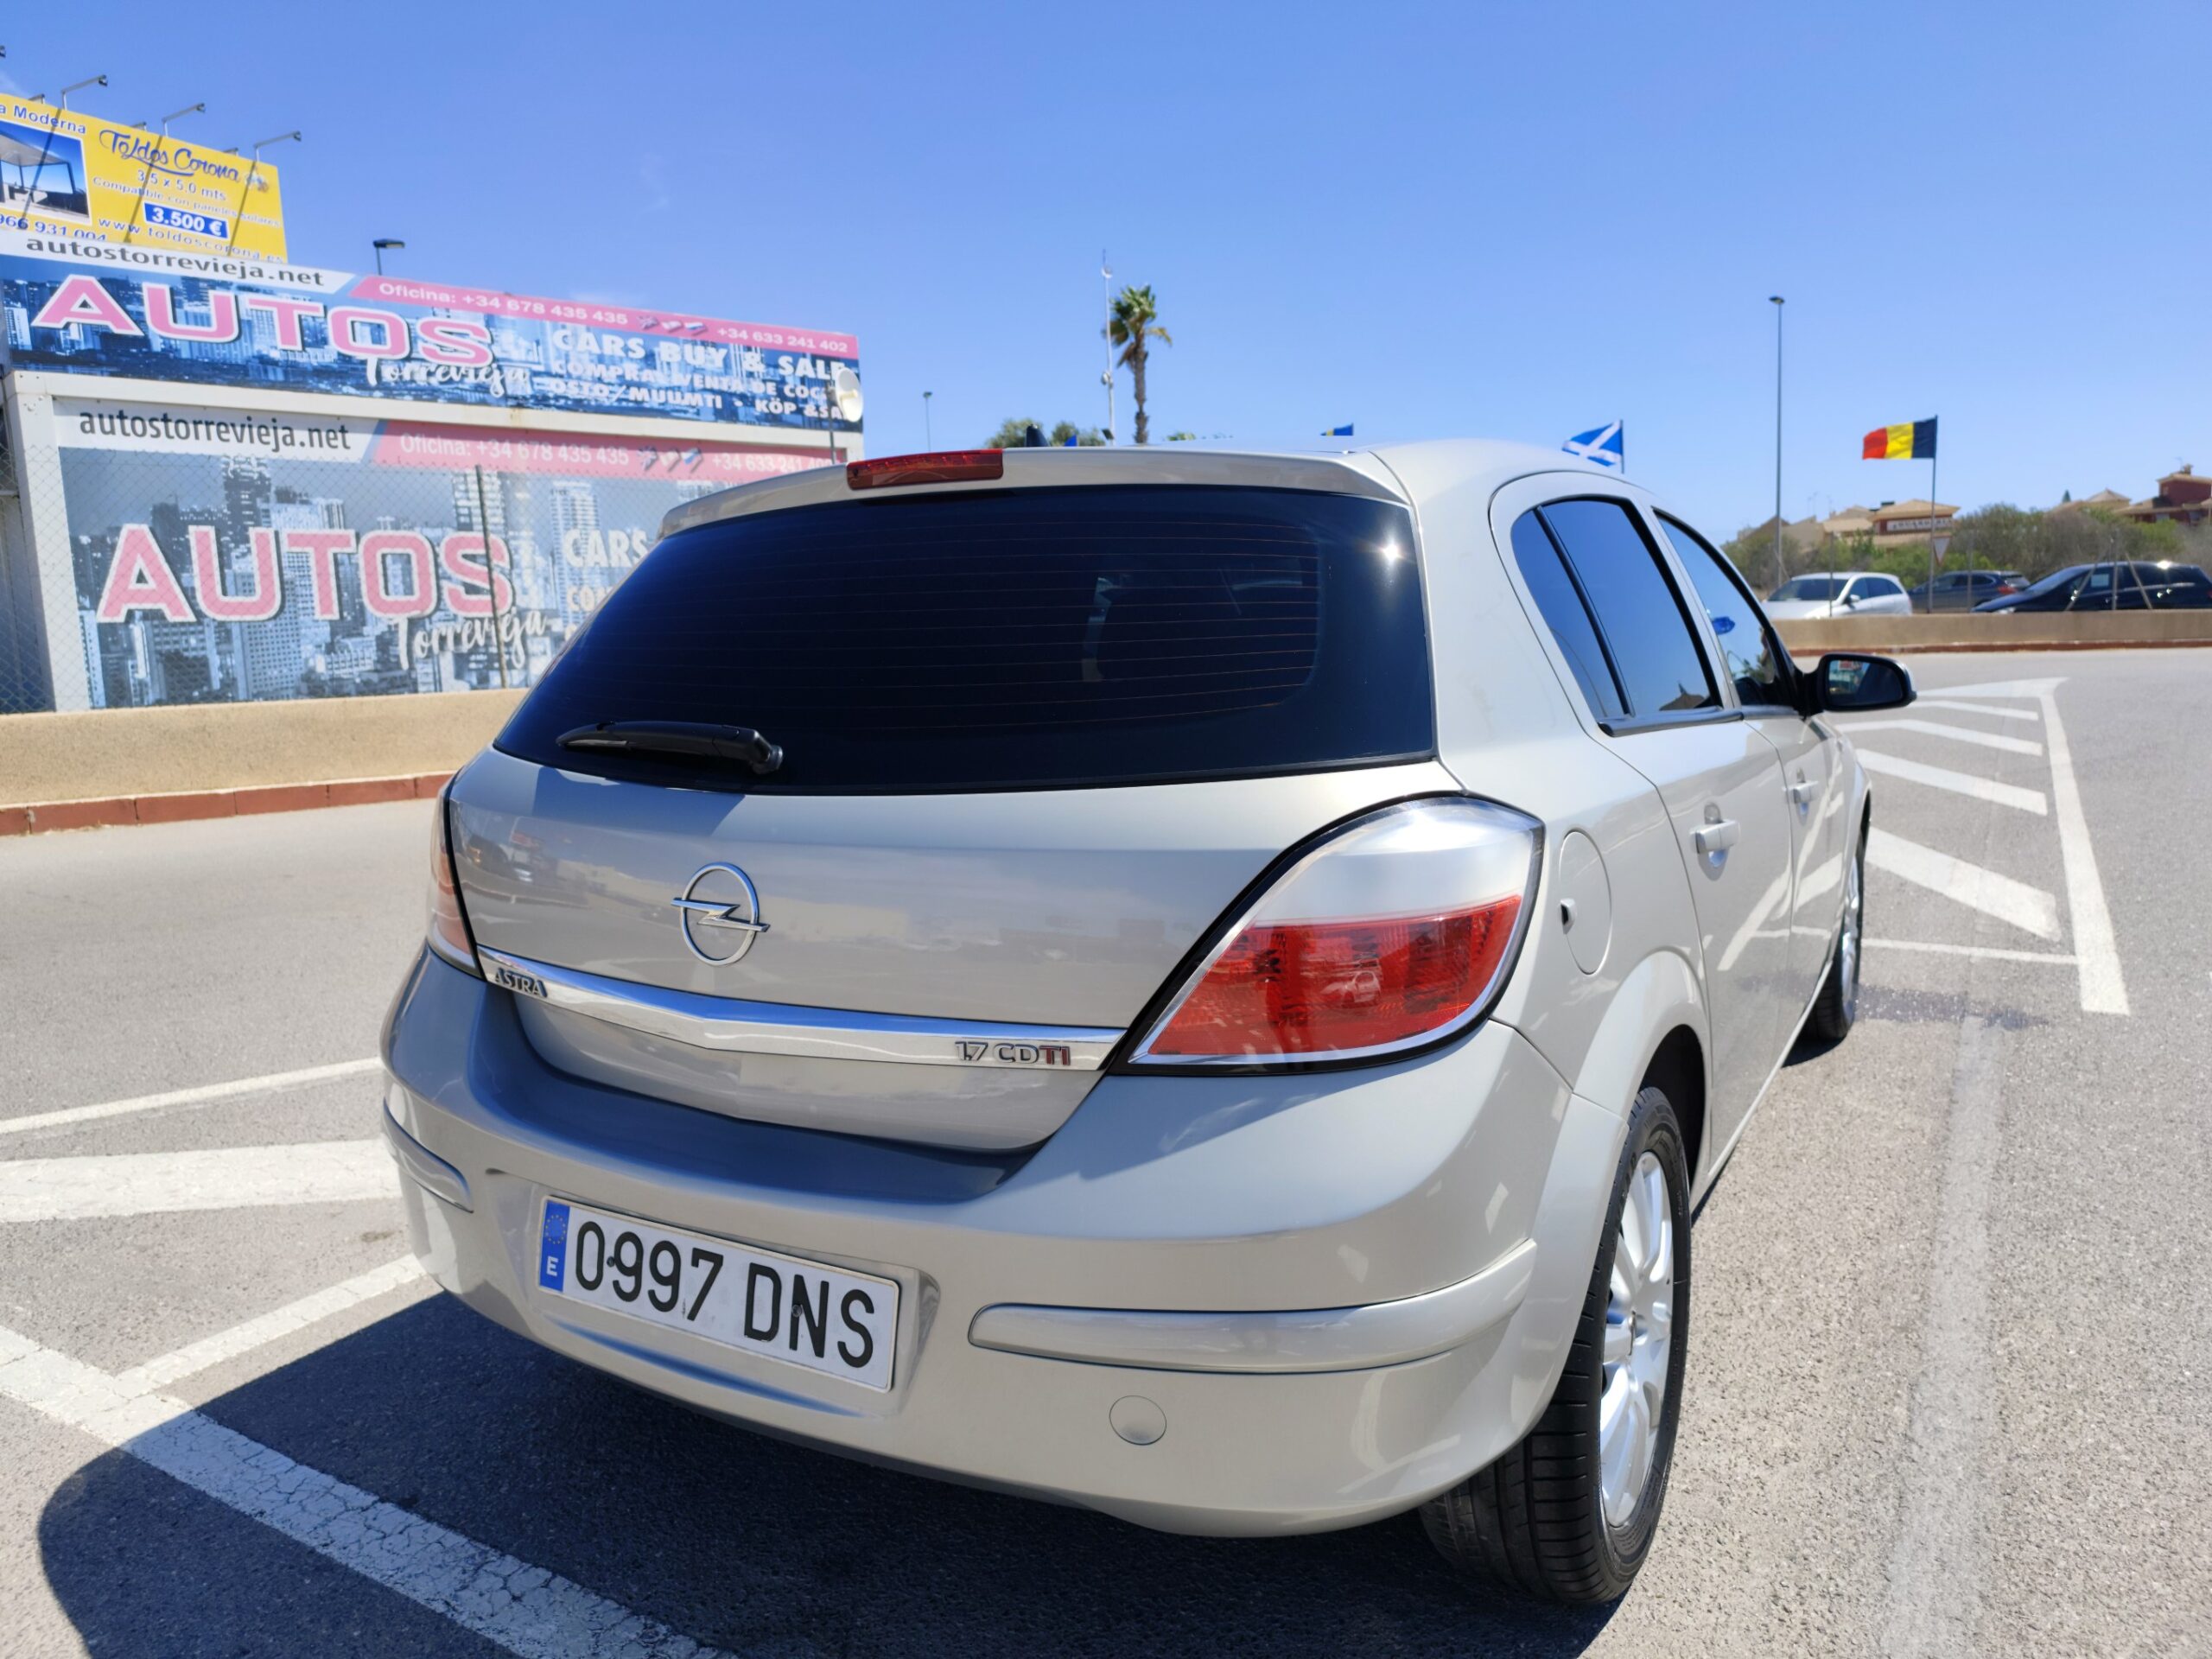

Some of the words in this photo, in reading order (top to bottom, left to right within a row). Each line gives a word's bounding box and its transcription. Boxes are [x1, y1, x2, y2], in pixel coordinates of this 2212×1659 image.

[14, 105, 86, 134] Moderna
[99, 130, 169, 168] Toldos
[174, 148, 240, 183] Corona
[92, 176, 163, 200] Compatible
[168, 194, 190, 207] con
[194, 200, 237, 217] paneles
[163, 179, 171, 188] x
[35, 220, 67, 236] 931
[152, 207, 205, 232] 3.500
[209, 219, 223, 237] €
[27, 238, 325, 286] autostorrevieja.net
[31, 274, 493, 367] AUTOS
[379, 283, 456, 303] Oficina:
[462, 294, 500, 309] +34
[506, 300, 545, 315] 678
[550, 303, 588, 320] 435
[593, 309, 628, 325] 435
[718, 327, 748, 340] +34
[753, 332, 784, 345] 633
[787, 335, 816, 349] 241
[819, 340, 848, 353] 402
[553, 329, 646, 359] CARS
[659, 340, 728, 369] BUY
[743, 352, 766, 373] &
[361, 356, 531, 398] Torrevieja
[551, 359, 655, 383] COMPRA
[752, 379, 778, 396] DE
[755, 397, 797, 415] KÖP
[79, 410, 351, 453] autostorrevieja.net
[401, 433, 471, 456] Oficina:
[477, 439, 512, 459] +34
[518, 441, 553, 461] 678
[558, 443, 591, 463] 435
[596, 446, 629, 466] 435
[712, 453, 741, 471] +34
[746, 454, 774, 473] 633
[95, 524, 513, 623] AUTOS
[495, 968, 549, 998] ASTRA
[994, 1043, 1071, 1065] CDTI
[546, 1255, 558, 1277] E
[575, 1221, 724, 1321] 0997
[744, 1262, 874, 1369] DNS
